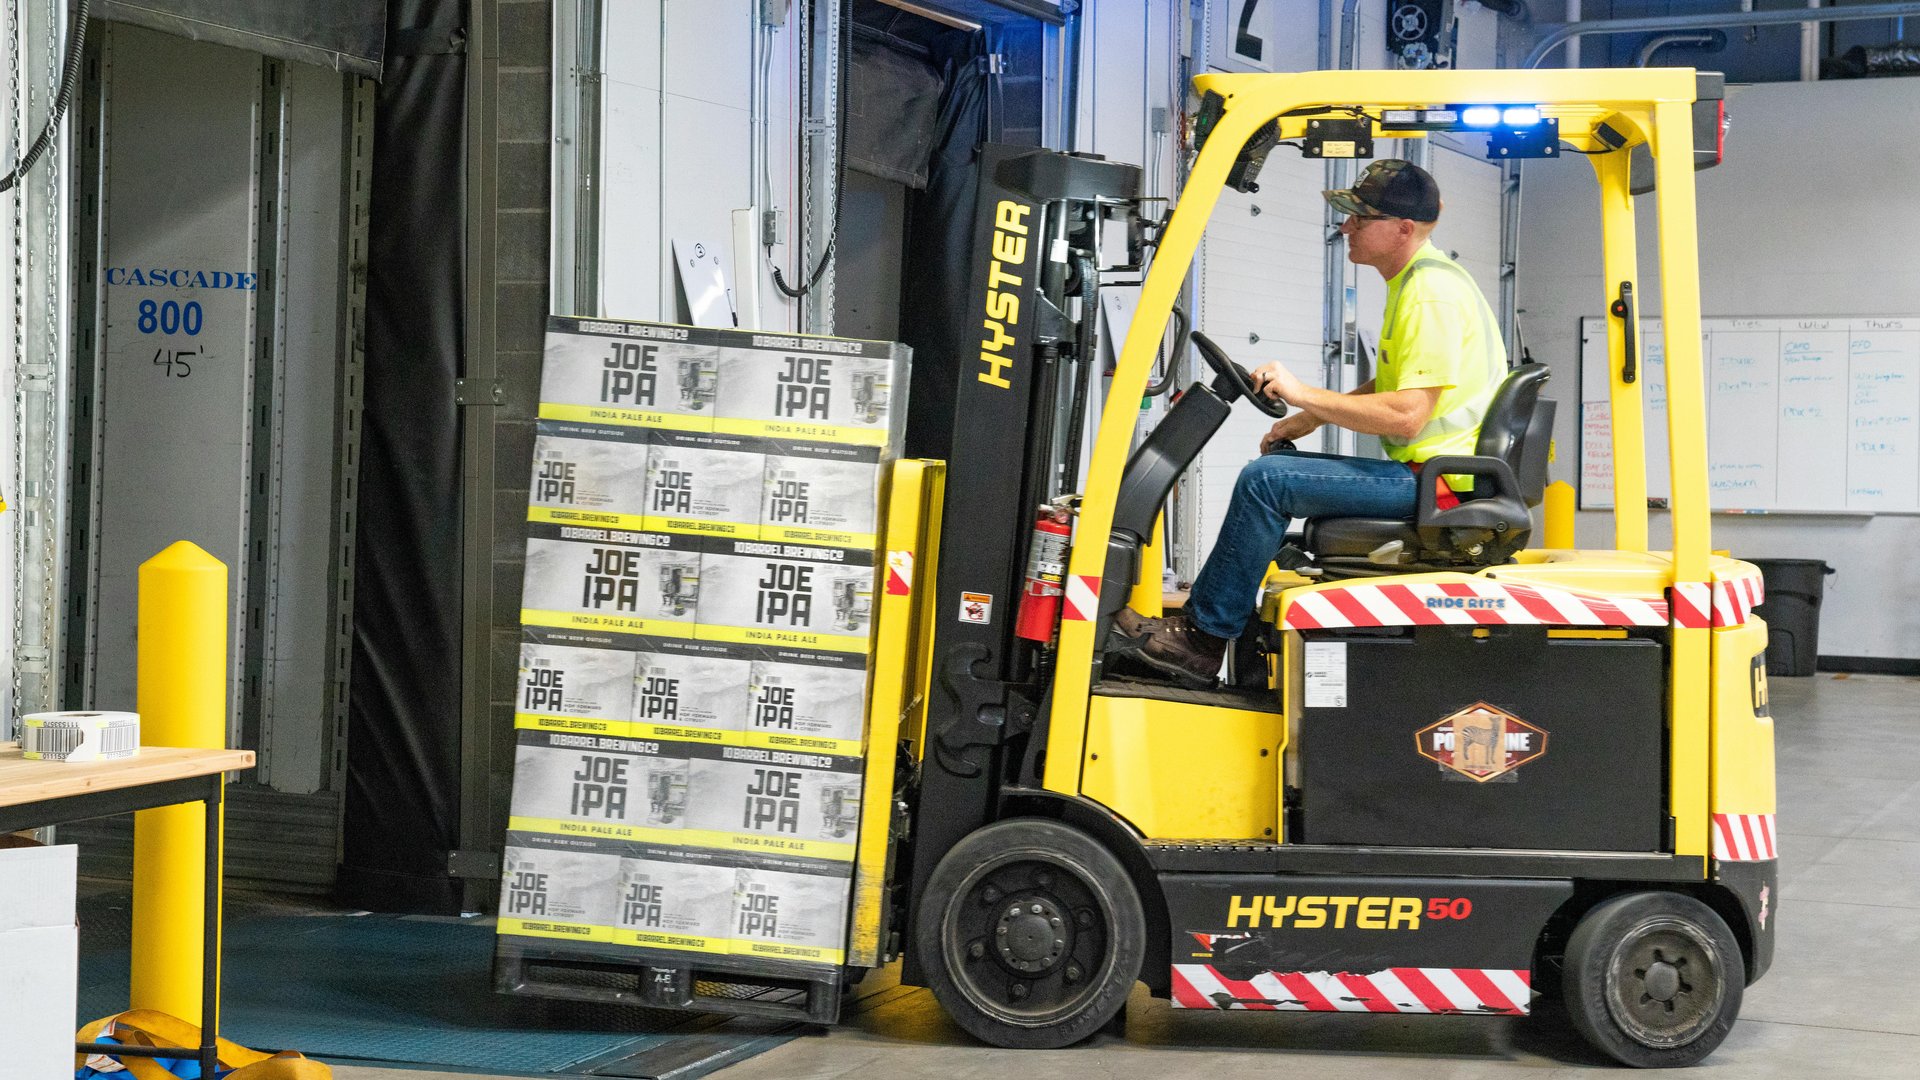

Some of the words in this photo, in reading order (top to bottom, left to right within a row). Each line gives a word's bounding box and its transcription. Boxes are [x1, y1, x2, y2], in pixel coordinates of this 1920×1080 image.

[107, 267, 257, 291] CASCADE
[978, 201, 1031, 389] HYSTER
[138, 299, 203, 336] 800
[604, 343, 659, 371] JOE
[778, 357, 832, 385] JOE
[601, 370, 656, 406] IPA
[775, 384, 830, 420] IPA
[590, 410, 617, 418] INDIA
[621, 412, 643, 421] PALE
[646, 414, 662, 422] ALE
[765, 425, 791, 433] INDIA
[796, 426, 816, 435] PALE
[821, 428, 836, 436] ALE
[538, 460, 576, 481] JOE
[655, 470, 693, 490] JOE
[536, 479, 575, 504] IPA
[653, 488, 691, 514] IPA
[772, 480, 809, 500] JOE
[770, 499, 808, 524] IPA
[586, 549, 640, 577] JOE
[759, 564, 814, 592] JOE
[583, 576, 638, 612] IPA
[1426, 597, 1464, 609] RIDE
[1468, 598, 1505, 609] RITE
[572, 616, 598, 624] INDIA
[603, 618, 624, 626] PALE
[756, 591, 811, 626] IPA
[746, 631, 772, 640] INDIA
[776, 633, 798, 642] PALE
[802, 635, 817, 643] ALE
[527, 668, 564, 688] JOE
[642, 677, 680, 697] JOE
[524, 686, 563, 712] IPA
[640, 695, 678, 721] IPA
[758, 685, 795, 706] JOE
[755, 704, 793, 730] IPA
[574, 755, 629, 785] JOE
[747, 769, 802, 799] JOE
[571, 783, 627, 819] IPA
[744, 796, 799, 833] IPA
[560, 823, 588, 832] INDIA
[591, 825, 613, 834] PALE
[616, 828, 632, 836] ALE
[733, 837, 760, 845] INDIA
[764, 839, 784, 848] PALE
[788, 841, 805, 850] ALE
[510, 871, 549, 892] JOE
[625, 883, 664, 904] JOE
[508, 890, 547, 916] IPA
[623, 902, 661, 927] IPA
[741, 893, 780, 914] JOE
[1227, 895, 1423, 930] HYSTER
[1426, 898, 1473, 921] 50
[739, 912, 777, 938] IPA
